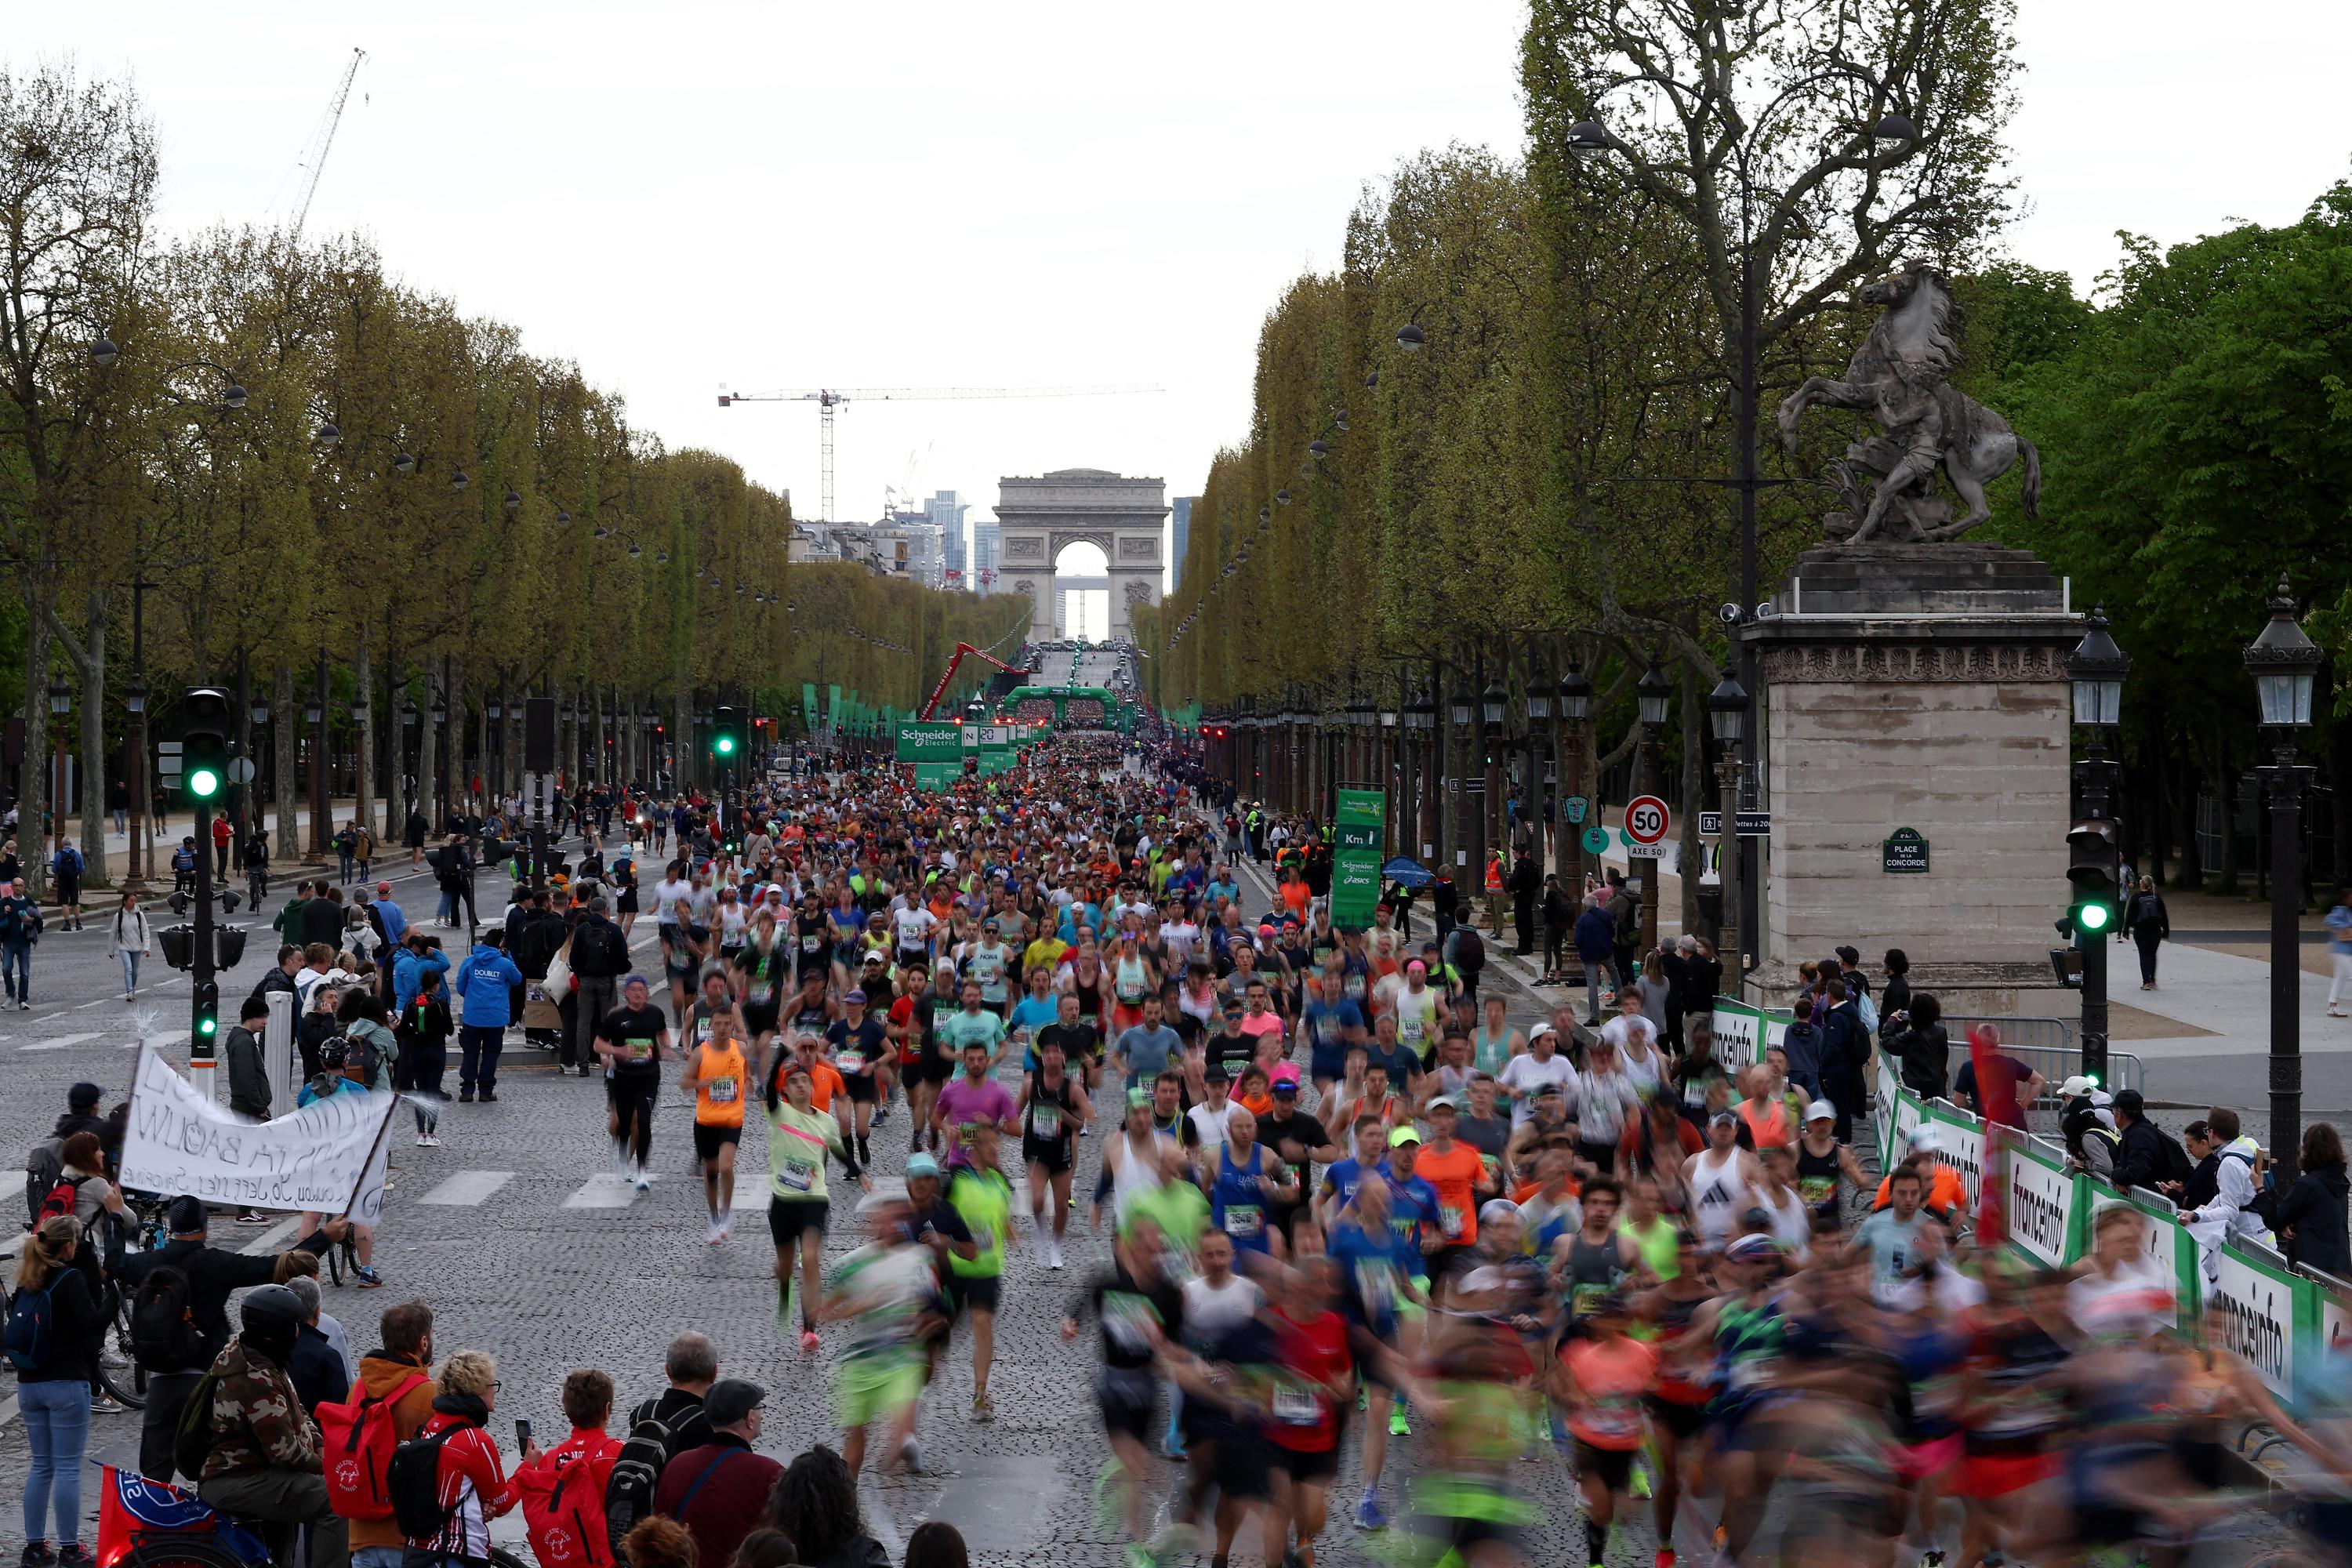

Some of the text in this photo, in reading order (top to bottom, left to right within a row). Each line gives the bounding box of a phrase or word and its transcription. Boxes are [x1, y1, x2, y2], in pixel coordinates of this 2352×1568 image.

[902, 729, 957, 739] Schneider
[1634, 811, 1661, 831] 50
[1345, 833, 1363, 844] Km
[1341, 862, 1374, 870] Schneider
[474, 969, 500, 978] DOUBLET
[1711, 1017, 1751, 1067] anceinfo
[2013, 1163, 2063, 1256] franceinfo
[2214, 1281, 2283, 1381] anceinfo
[544, 1527, 560, 1544] ATHLETIC
